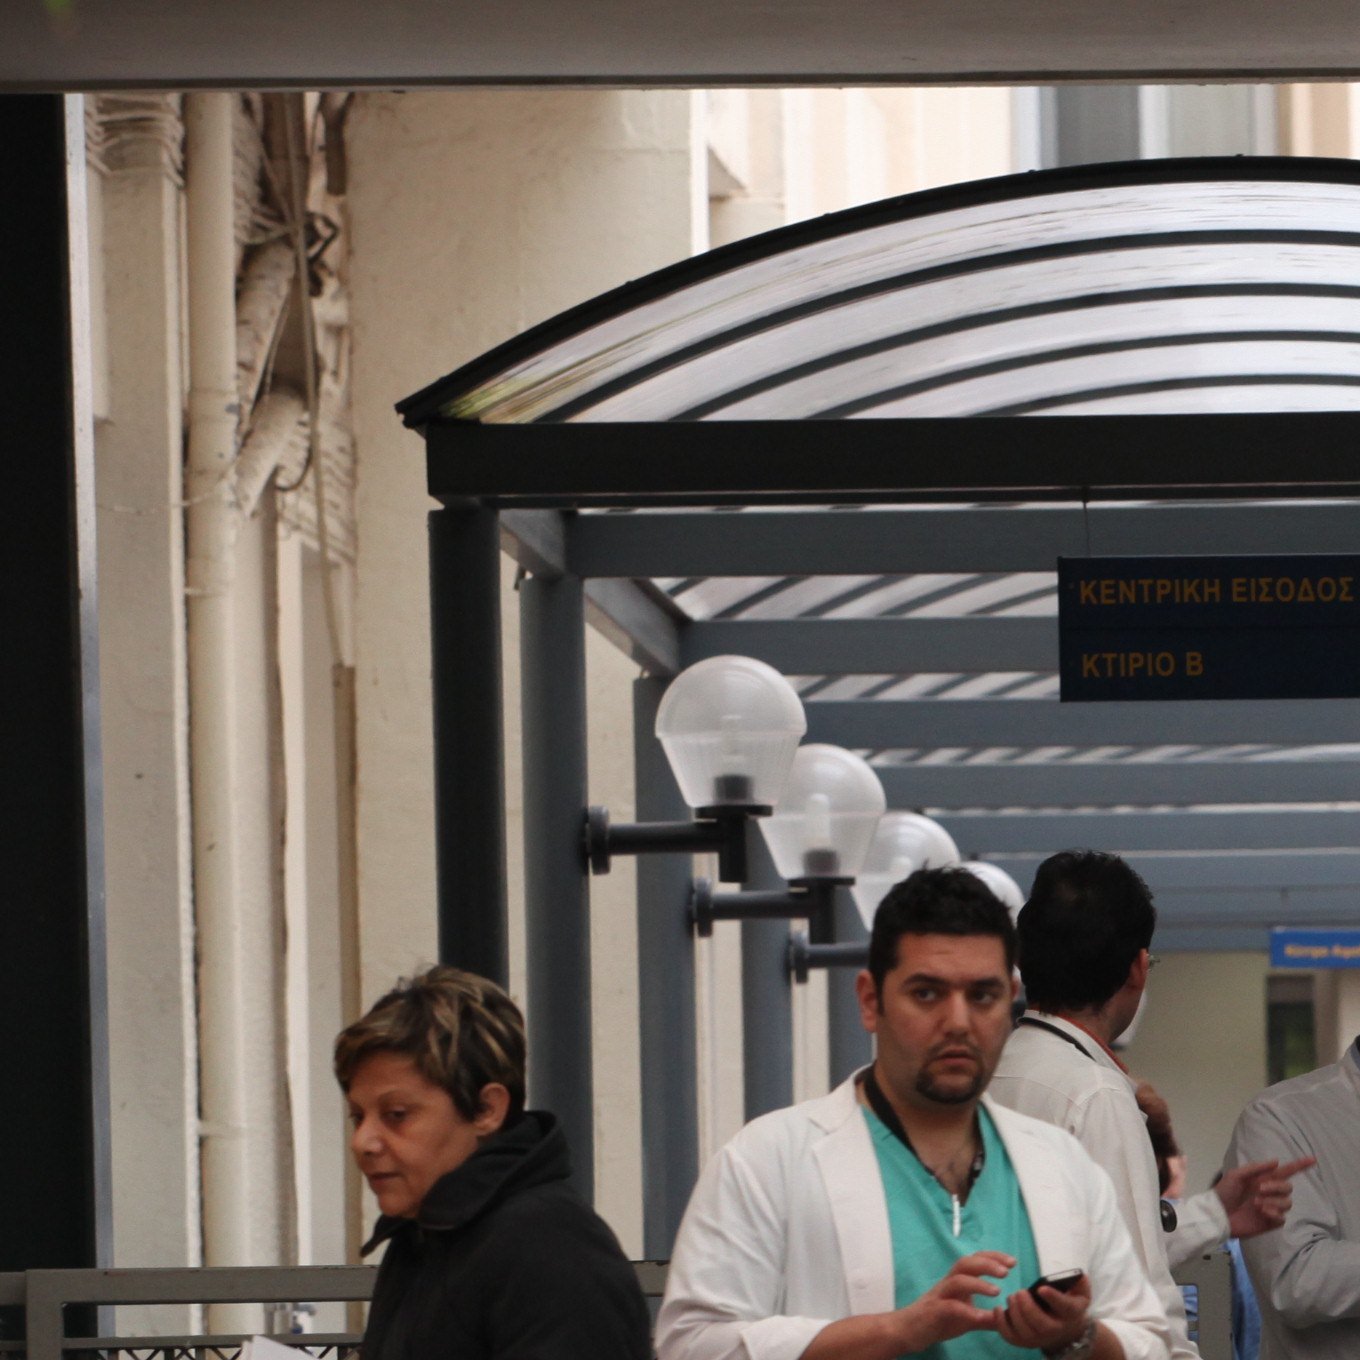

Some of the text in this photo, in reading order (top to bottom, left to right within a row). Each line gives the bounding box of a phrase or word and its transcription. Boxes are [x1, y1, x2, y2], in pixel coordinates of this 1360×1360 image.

[1079, 576, 1355, 605] ΚΕΝΤΡΙΚΗ ΕΙΣΟΔΟΣ
[1082, 651, 1204, 677] ΚΤΙΡΙΟ Β
